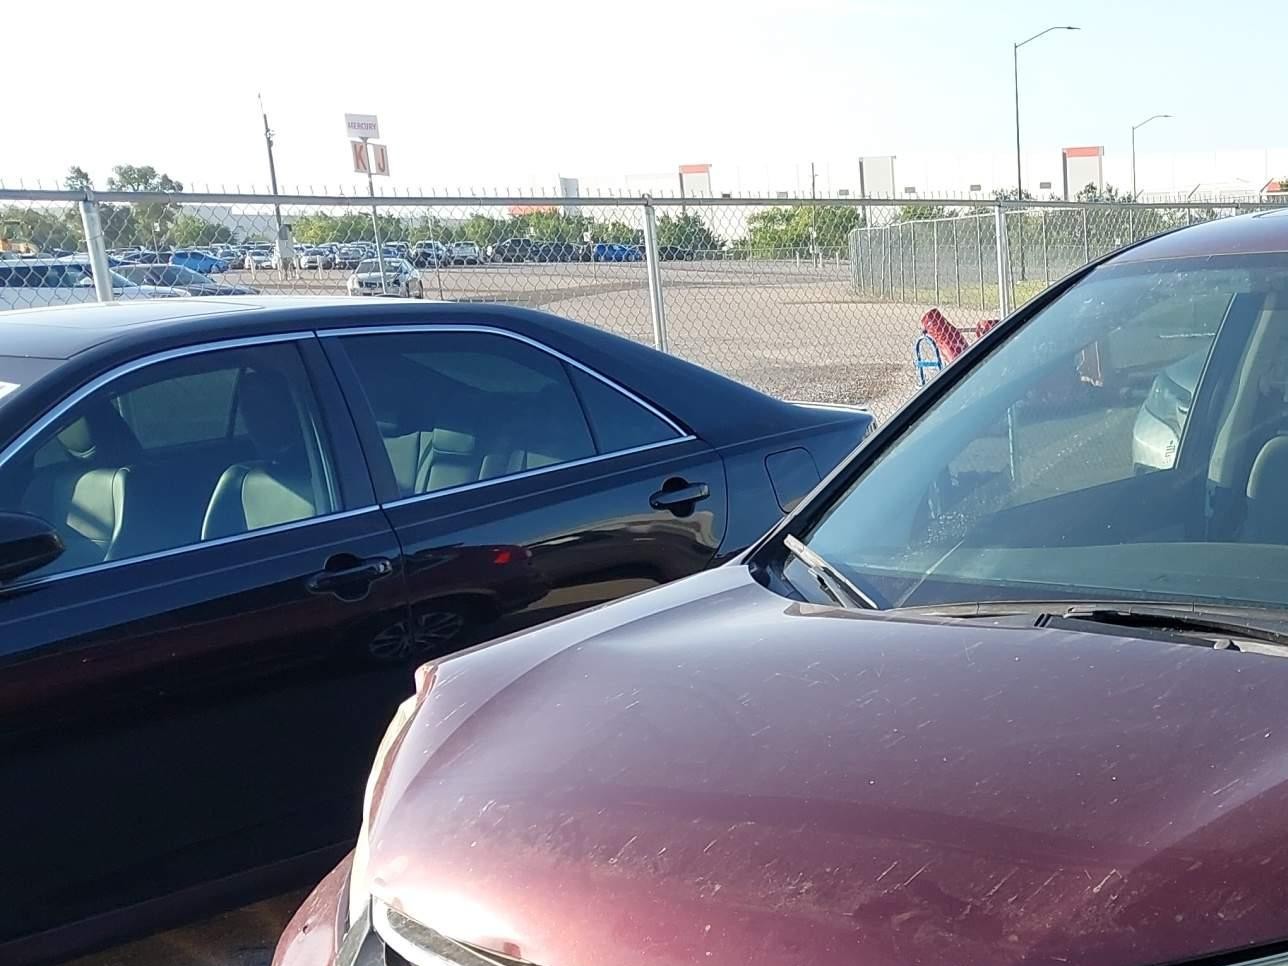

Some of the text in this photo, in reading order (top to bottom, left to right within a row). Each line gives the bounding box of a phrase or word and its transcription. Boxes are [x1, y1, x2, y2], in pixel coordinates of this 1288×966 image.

[347, 121, 377, 130] MERCURY
[354, 143, 367, 170] K
[378, 147, 386, 173] J
